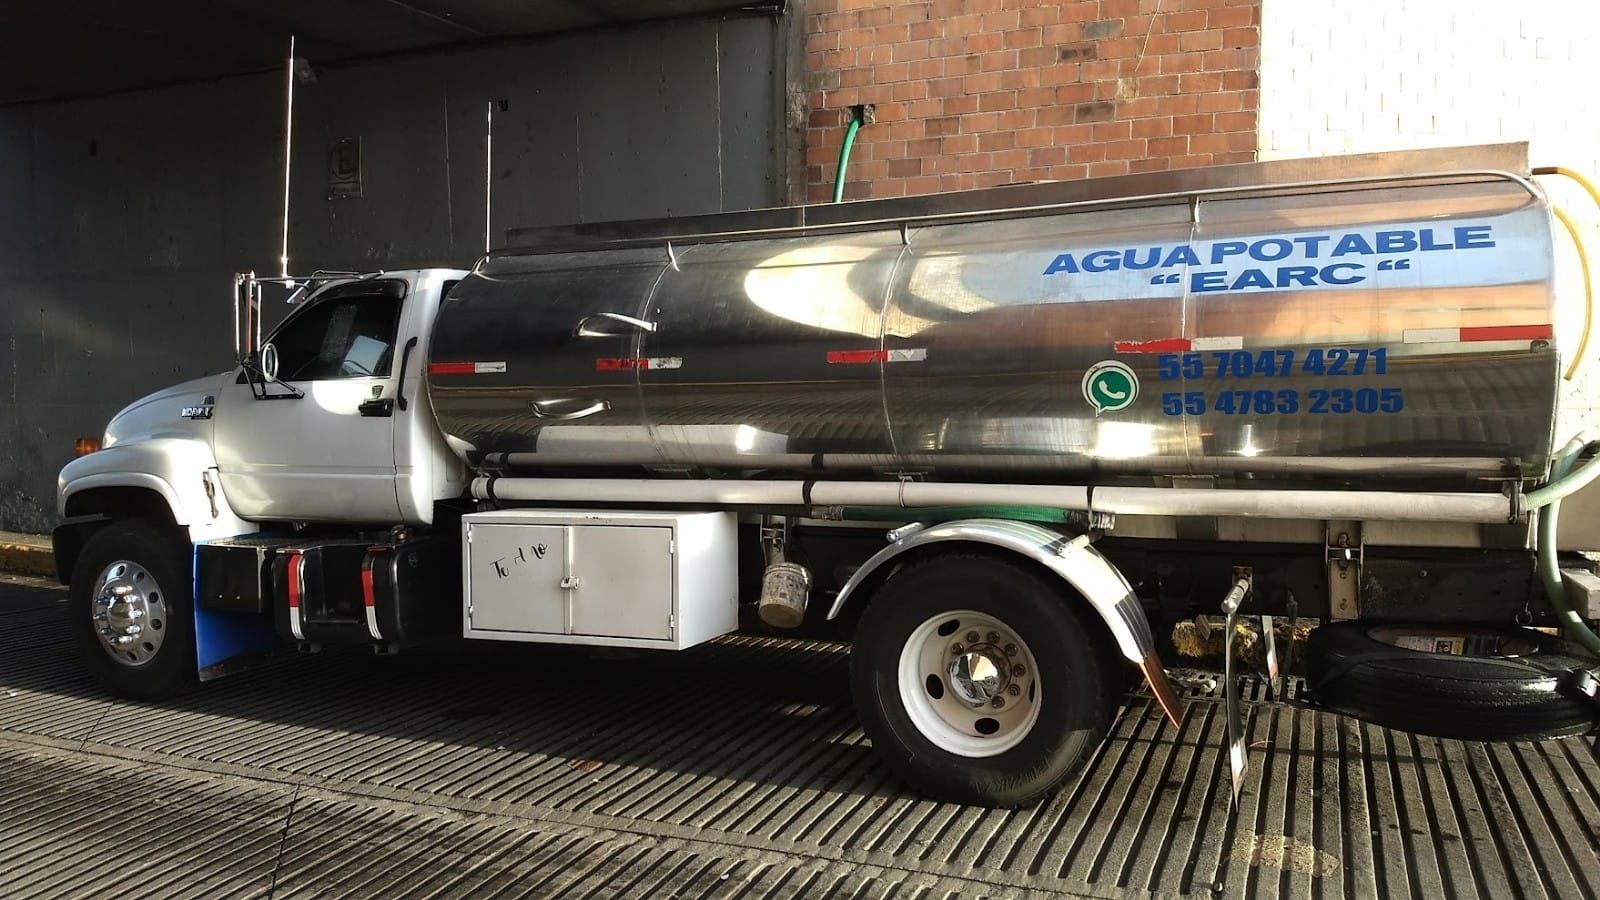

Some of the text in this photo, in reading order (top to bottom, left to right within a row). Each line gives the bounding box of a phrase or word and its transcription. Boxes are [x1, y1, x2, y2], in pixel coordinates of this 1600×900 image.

[1043, 225, 1496, 276] AGUA POTABLE
[1158, 347, 1387, 380] 55 7047 4271
[1162, 387, 1404, 416] 55 4783 2305
